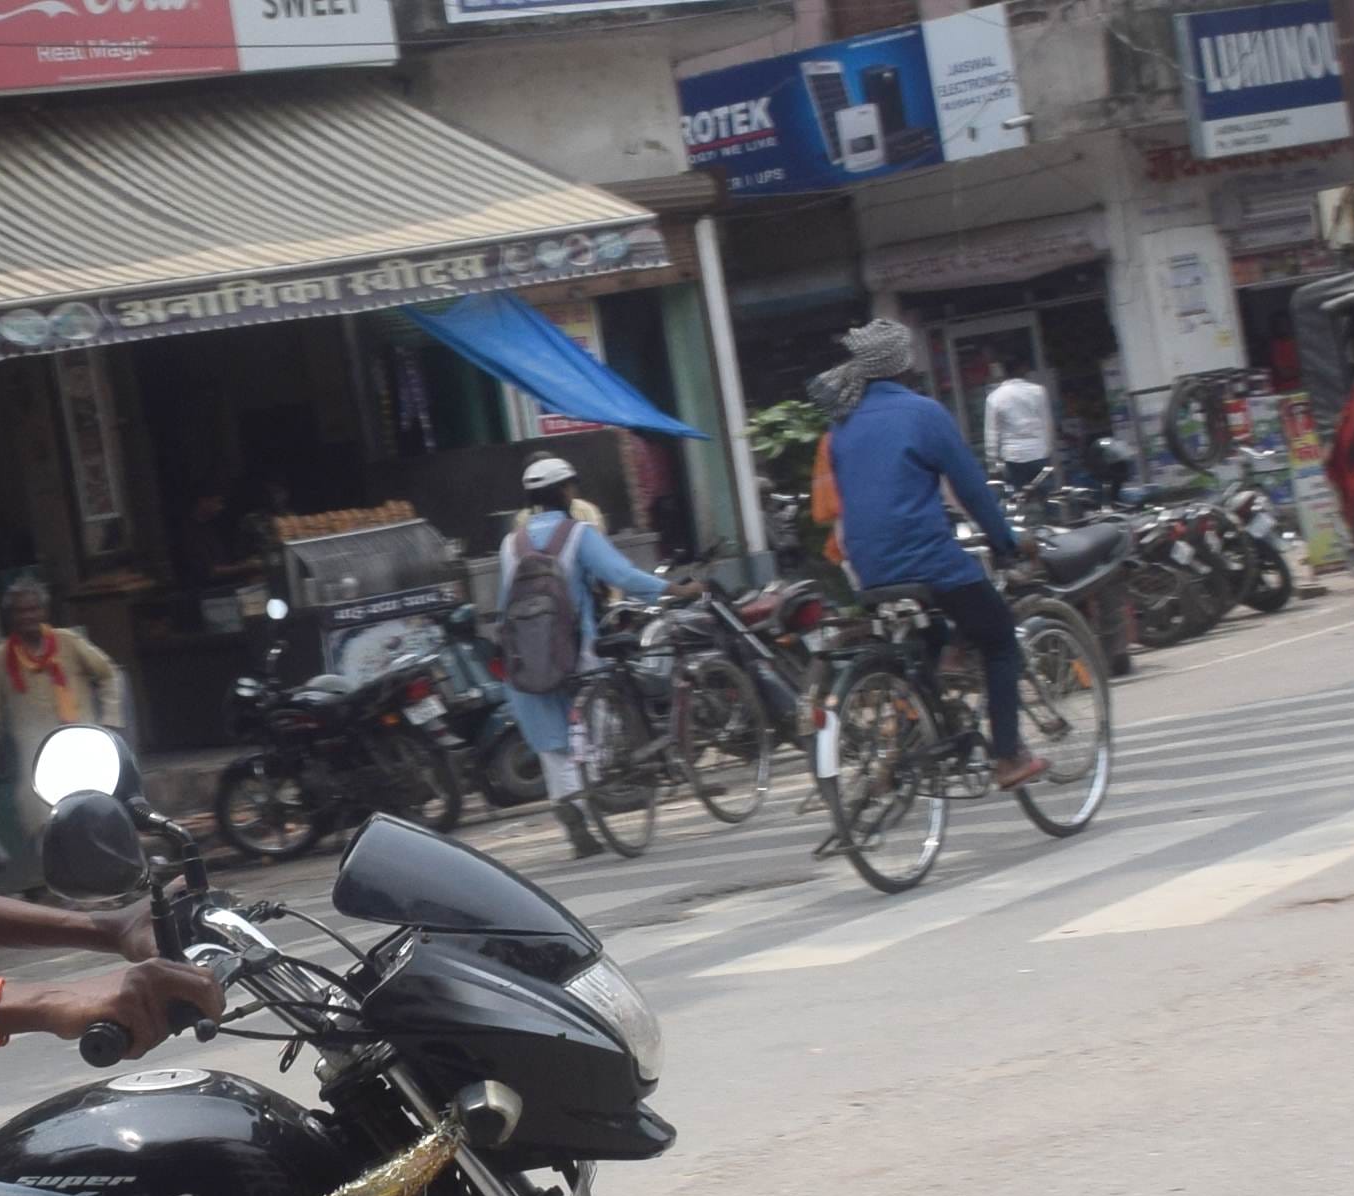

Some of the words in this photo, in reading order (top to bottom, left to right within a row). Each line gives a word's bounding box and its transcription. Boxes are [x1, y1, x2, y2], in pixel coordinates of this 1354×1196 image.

[37, 41, 86, 62] Real
[88, 37, 154, 61] Magic
[1198, 20, 1343, 93] LUMINOU
[680, 97, 775, 146] ROTEK
[115, 274, 343, 327] अनामिका
[15, 1175, 137, 1190] super
